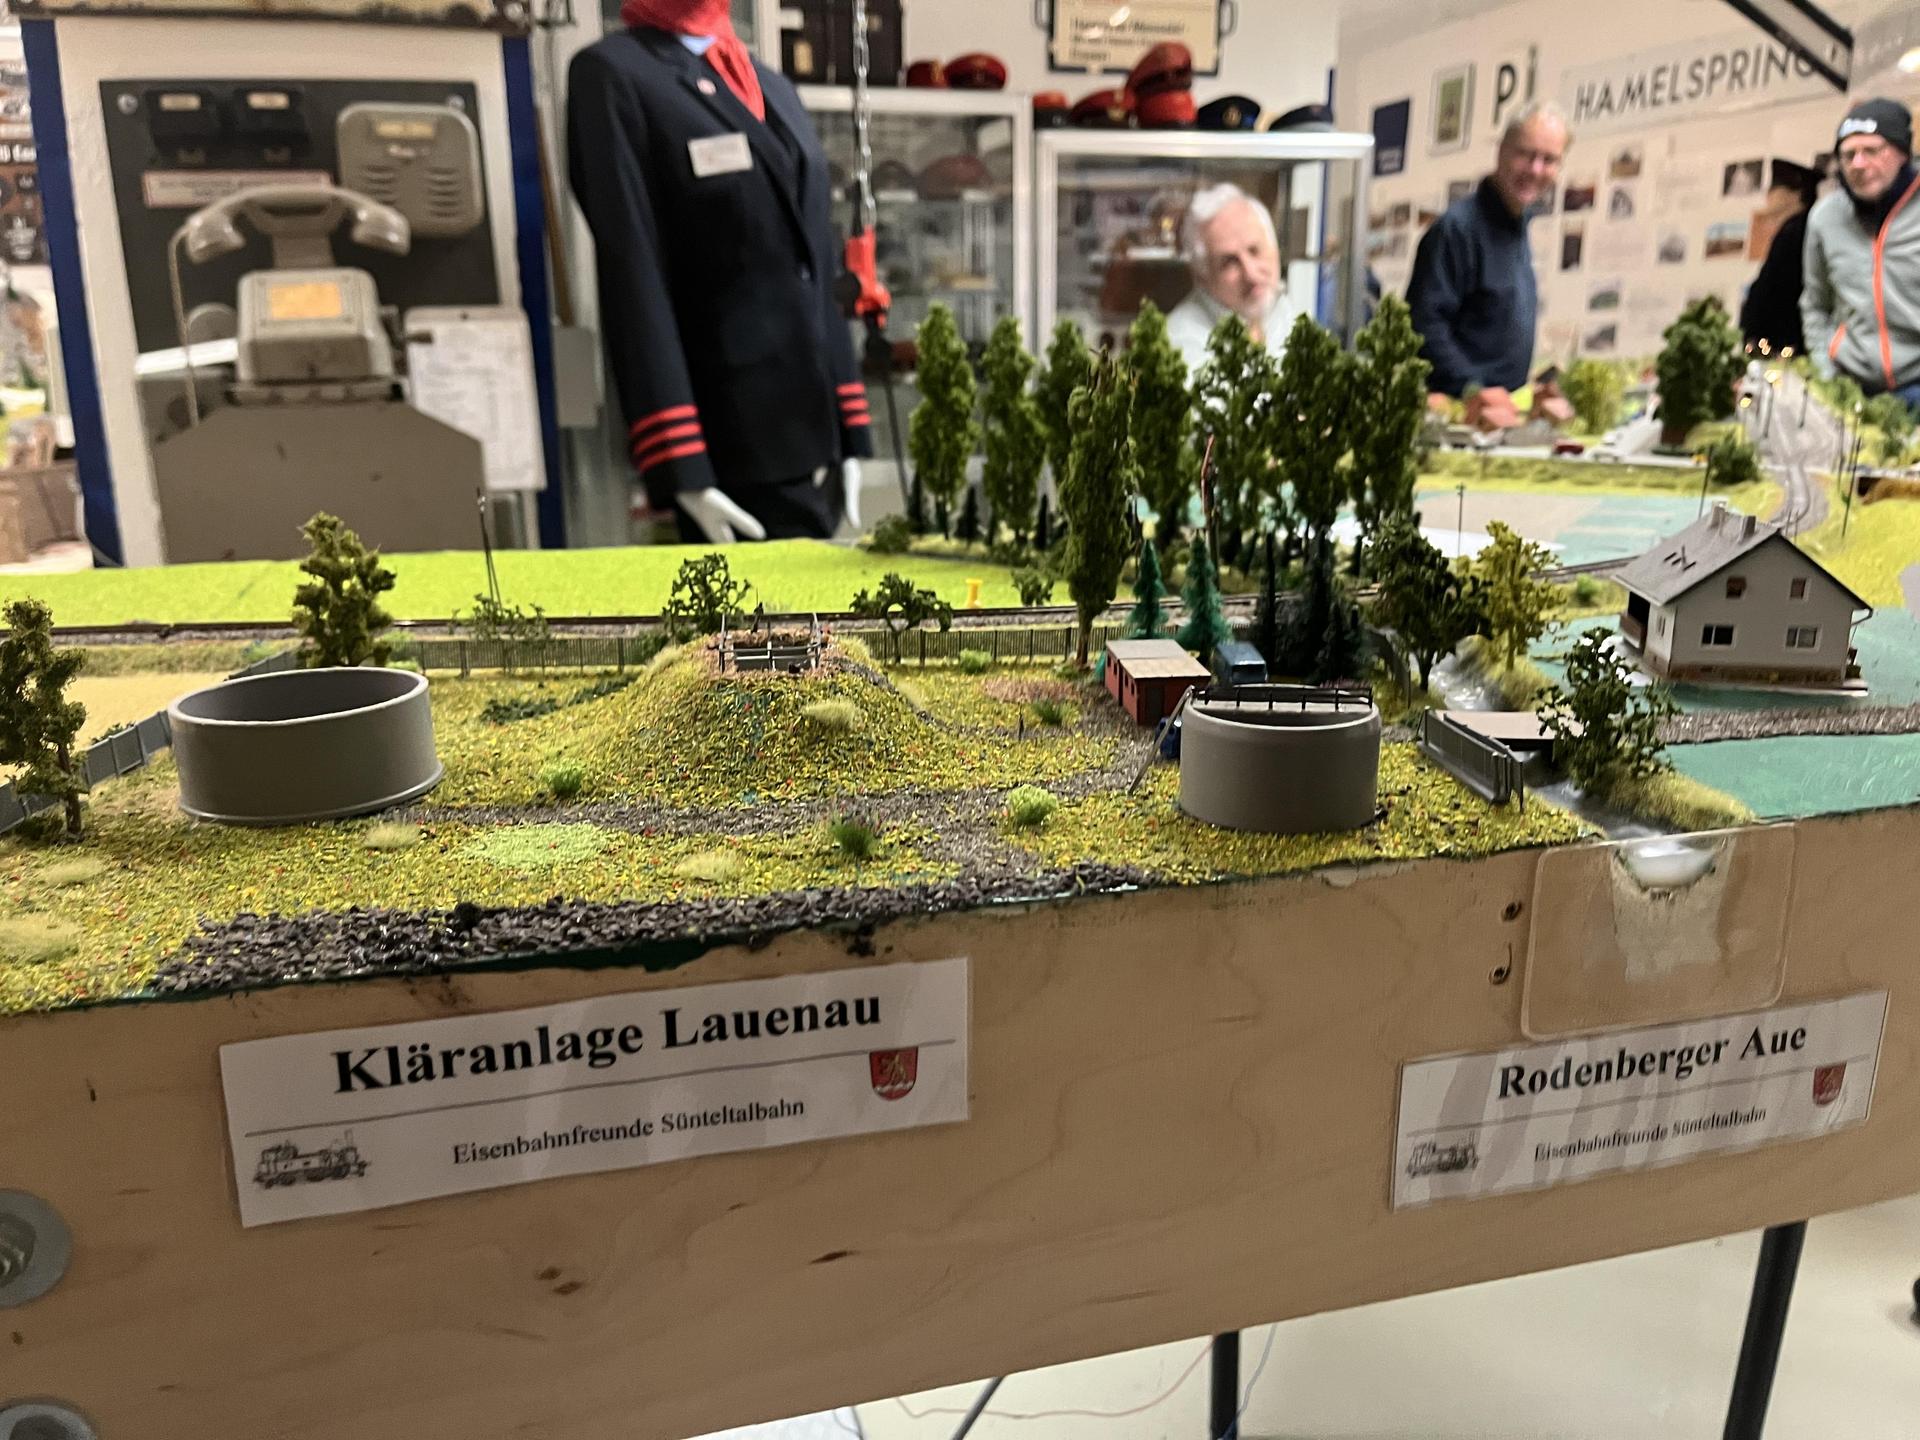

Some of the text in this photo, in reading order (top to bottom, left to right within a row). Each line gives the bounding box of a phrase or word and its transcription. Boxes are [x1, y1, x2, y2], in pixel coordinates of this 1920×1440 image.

[331, 995, 881, 1095] Kläranlage Lauenau
[1498, 1024, 1807, 1100] Rodenberger Aue
[452, 1096, 806, 1166] Eisenbahnfreunde Sünteltalbahn
[1533, 1103, 1768, 1163] Eisenbahnfreunde Sünteltalbahn
